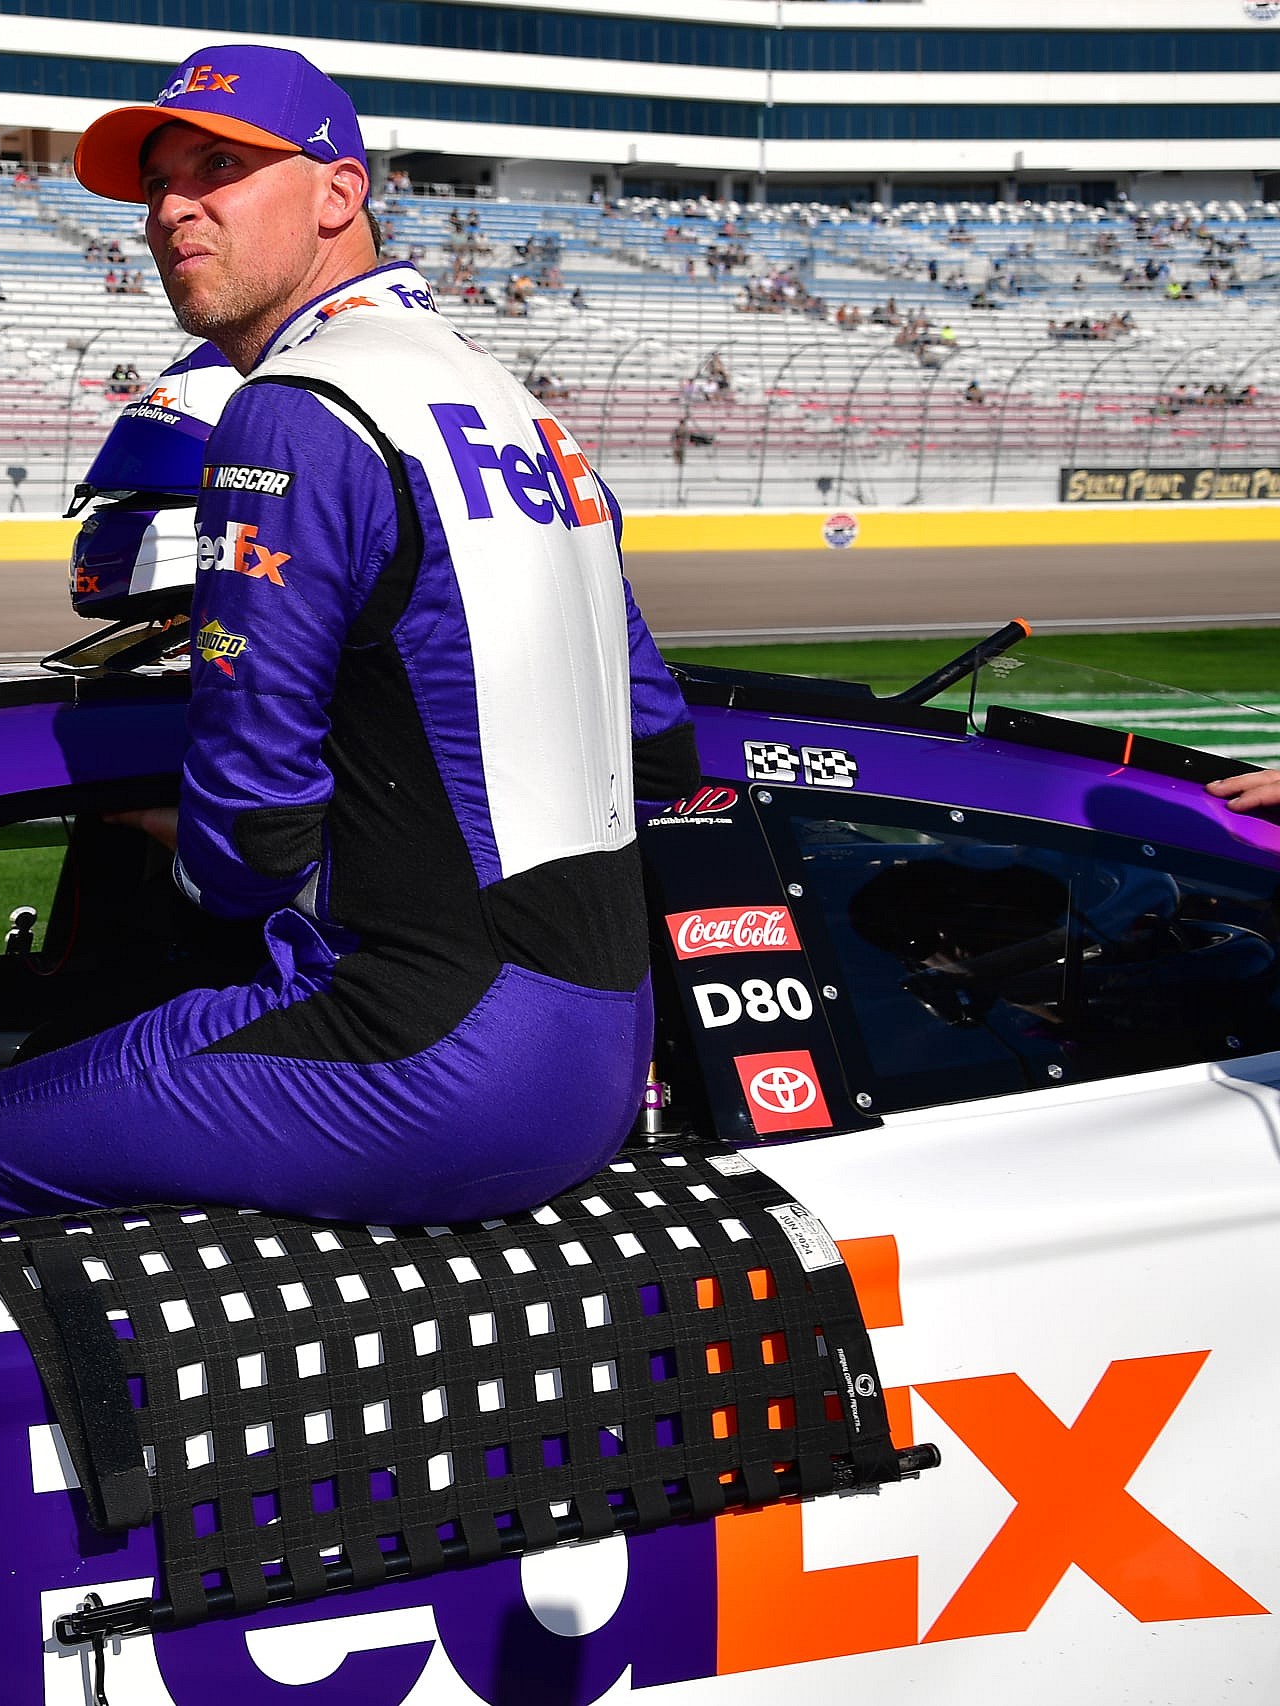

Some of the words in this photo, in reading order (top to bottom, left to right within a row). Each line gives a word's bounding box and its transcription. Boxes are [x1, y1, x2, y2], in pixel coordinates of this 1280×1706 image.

[214, 466, 290, 496] NASCAR
[195, 521, 292, 587] edEx
[677, 910, 788, 953] Coca-Cola
[692, 977, 813, 1029] D80
[779, 1215, 799, 1230] JUN
